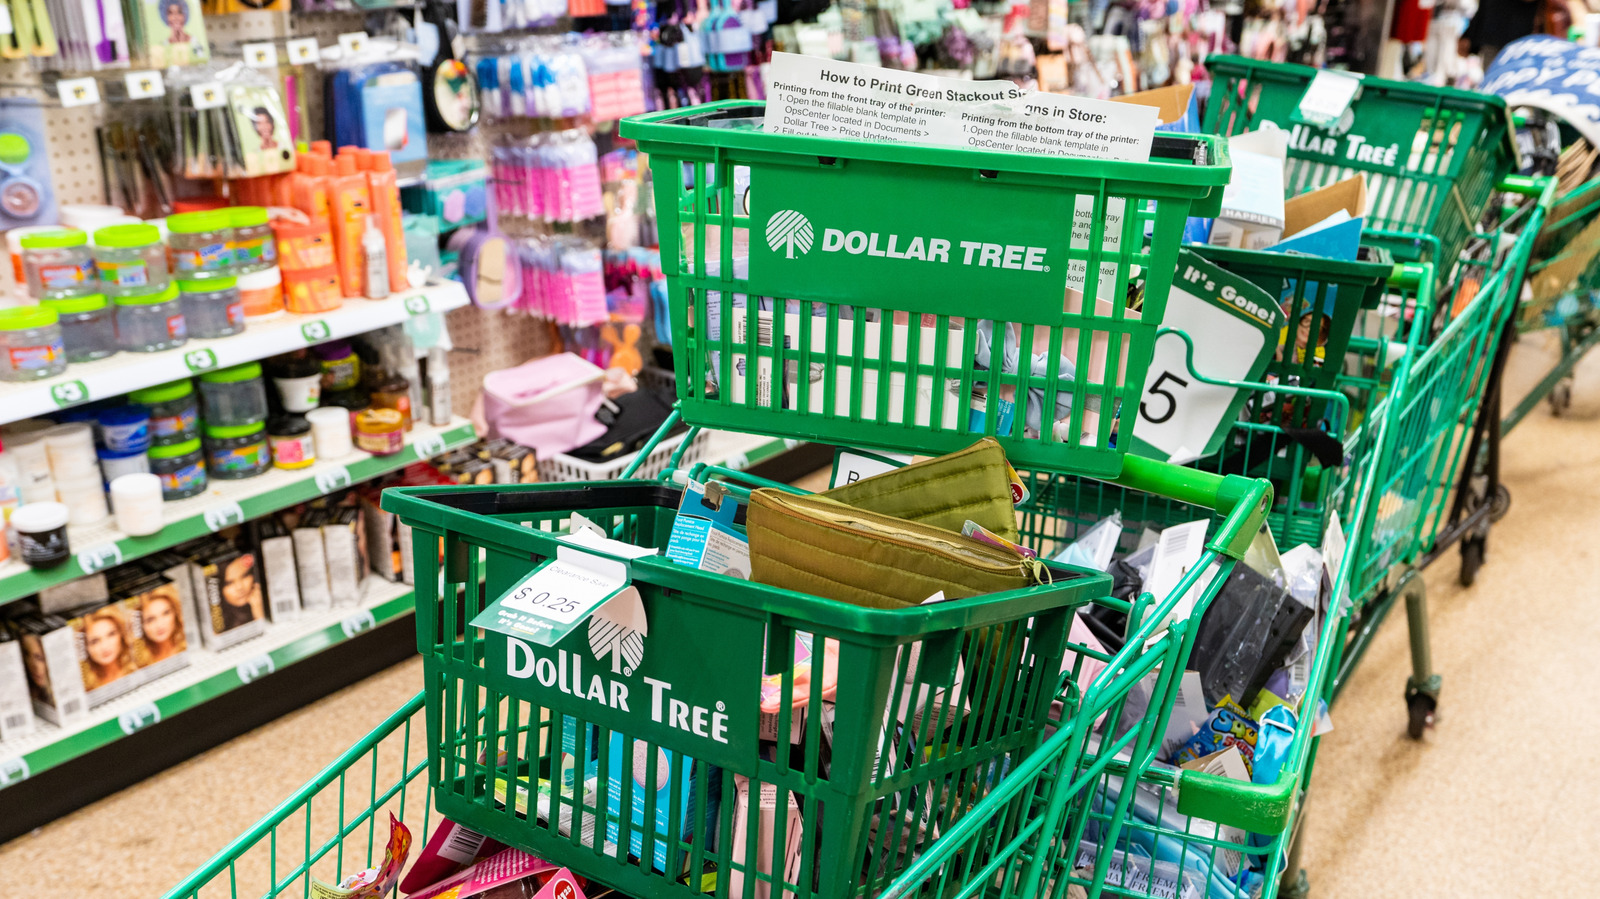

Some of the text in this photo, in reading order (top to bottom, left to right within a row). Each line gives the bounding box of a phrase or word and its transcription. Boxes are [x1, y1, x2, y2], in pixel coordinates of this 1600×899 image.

[773, 81, 947, 118] Printing from the front tray of the printer:
[820, 69, 850, 84] How
[853, 76, 866, 87] to
[870, 78, 902, 94] Print
[906, 84, 943, 100] Green
[946, 89, 1004, 102] Stackout
[778, 93, 927, 126] 1. Open the fillable blank template in
[785, 105, 830, 120] OpsCenter
[832, 113, 862, 126] located
[864, 120, 872, 128] in
[874, 121, 922, 137] Documents
[1053, 106, 1065, 118] in
[1068, 108, 1107, 124] Store:
[783, 116, 808, 127] Dollar
[810, 120, 829, 132] Tree
[839, 126, 861, 138] Price
[961, 112, 1140, 145] Printing from the bottom tray of the printer:
[962, 124, 1109, 153] 1. Open the fillable blank template in
[968, 136, 1013, 151] OpsCenter
[1015, 144, 1046, 154] located
[1226, 209, 1277, 225] HAPPIER
[822, 228, 1048, 273] DOLLAR TREE
[1183, 265, 1276, 325] It's Gone!
[549, 565, 590, 582] Clearance
[514, 587, 581, 614] $ 0.25
[497, 609, 518, 619] Grab
[528, 615, 554, 630] Before
[643, 675, 729, 744] TREE
